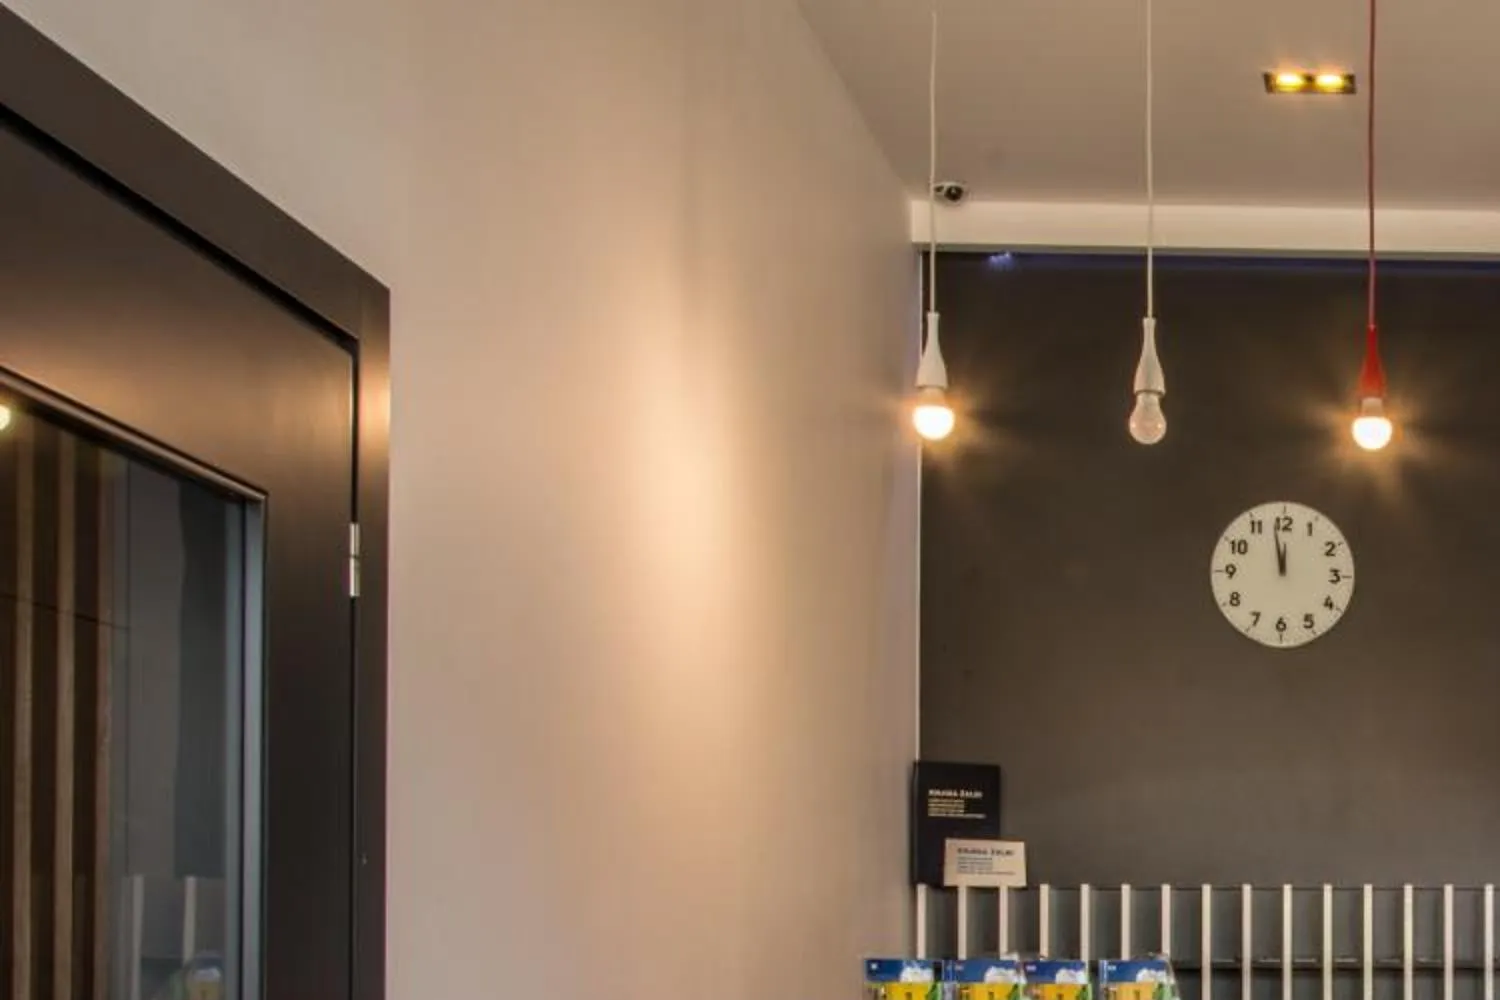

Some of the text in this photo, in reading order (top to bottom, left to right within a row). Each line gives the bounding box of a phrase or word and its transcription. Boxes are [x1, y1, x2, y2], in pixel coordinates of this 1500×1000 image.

[1251, 520, 1262, 534] 11
[1276, 517, 1293, 531] 12
[1307, 522, 1313, 536] 1
[1230, 539, 1248, 555] 10
[1324, 541, 1336, 557] 2
[1225, 564, 1236, 579] 9
[1328, 568, 1341, 584] 3
[1229, 592, 1240, 607] 8
[1323, 596, 1334, 610] 4
[1251, 612, 1261, 627] 7
[1275, 617, 1287, 632] 6
[1303, 614, 1314, 629] 5
